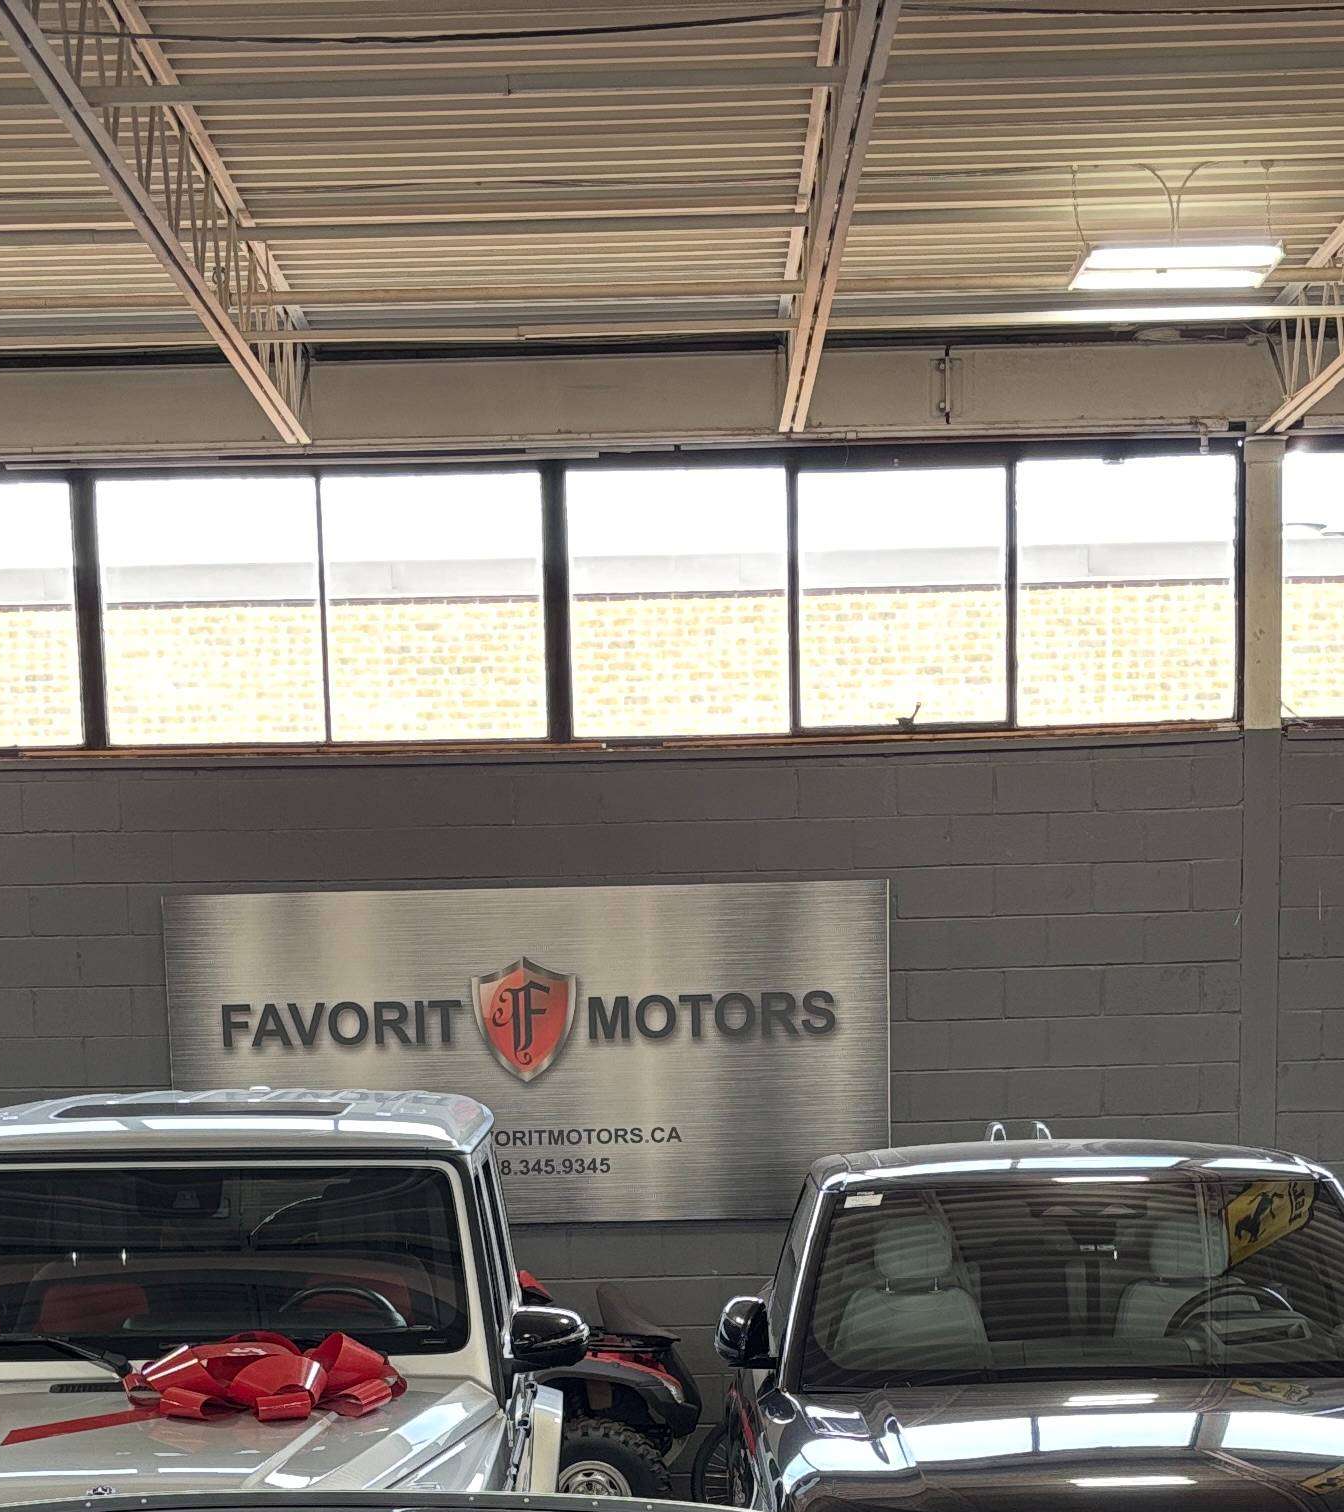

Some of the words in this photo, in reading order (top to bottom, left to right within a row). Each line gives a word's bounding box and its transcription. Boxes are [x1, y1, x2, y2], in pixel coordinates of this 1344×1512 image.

[221, 1000, 463, 1048] FAVORIT
[587, 990, 836, 1040] MOTORS
[491, 1126, 683, 1147] ORITMOTORS.CA
[500, 1157, 611, 1176] 8.345.9345
